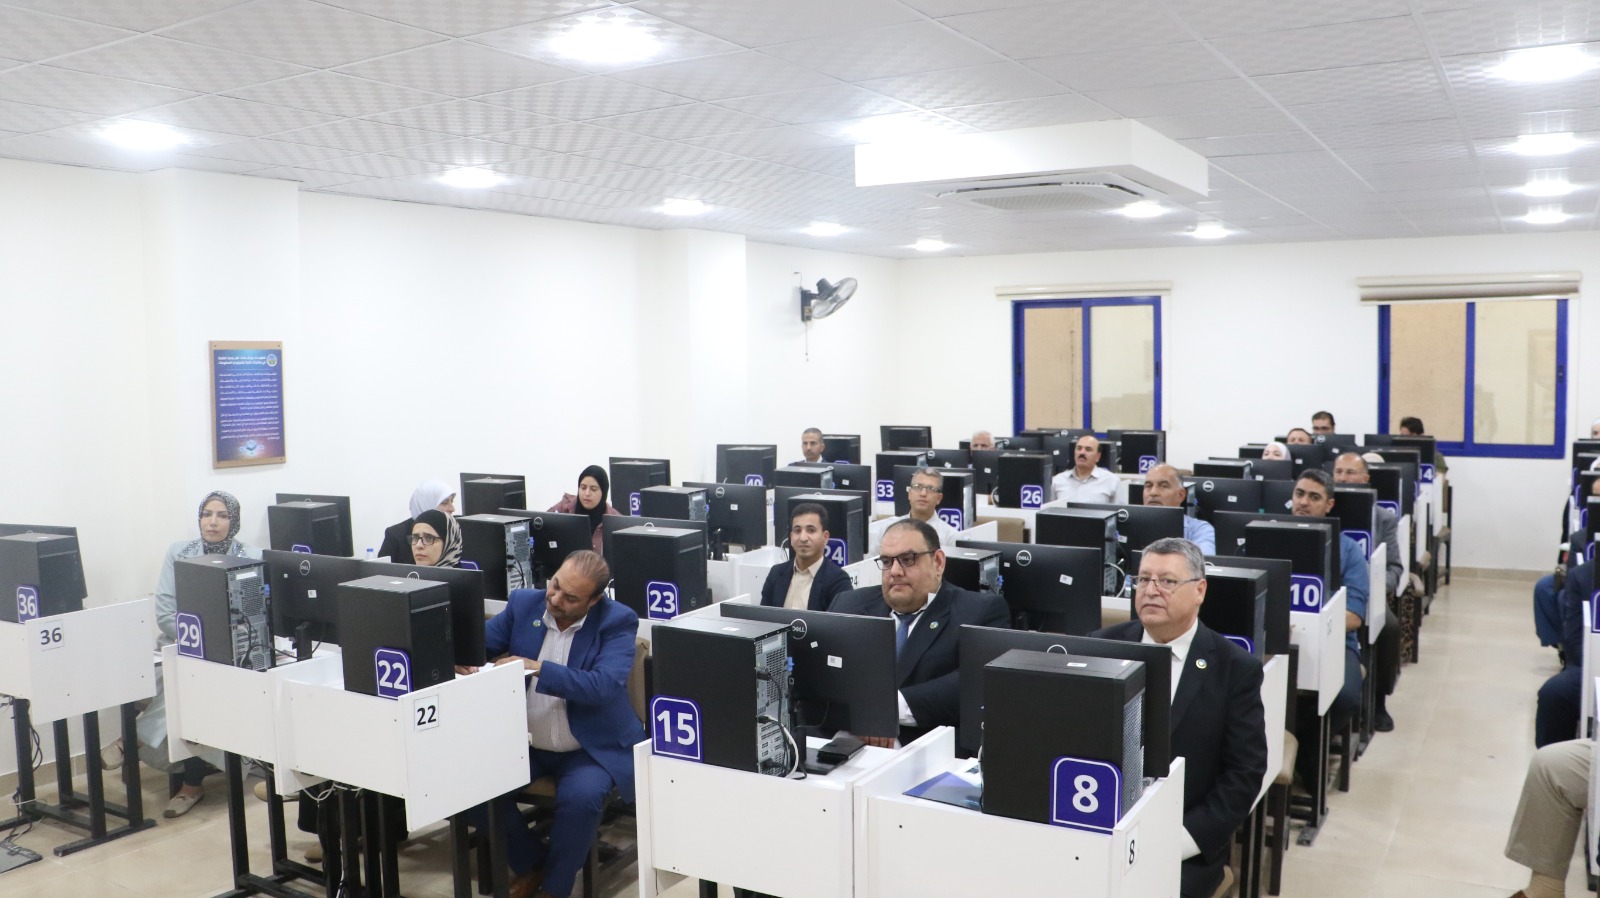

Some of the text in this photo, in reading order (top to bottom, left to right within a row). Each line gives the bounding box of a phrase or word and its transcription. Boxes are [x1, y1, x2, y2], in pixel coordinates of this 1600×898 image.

[877, 484, 894, 498] 33
[1022, 490, 1041, 504] 26
[18, 593, 36, 617] 36
[649, 589, 676, 614] 23
[1290, 583, 1320, 607] 10
[40, 626, 62, 646] 36
[178, 621, 200, 648] 29
[377, 659, 408, 691] 22
[416, 704, 437, 726] 22
[656, 709, 696, 746] 15
[1072, 774, 1099, 813] 8
[1128, 838, 1135, 866] 8
